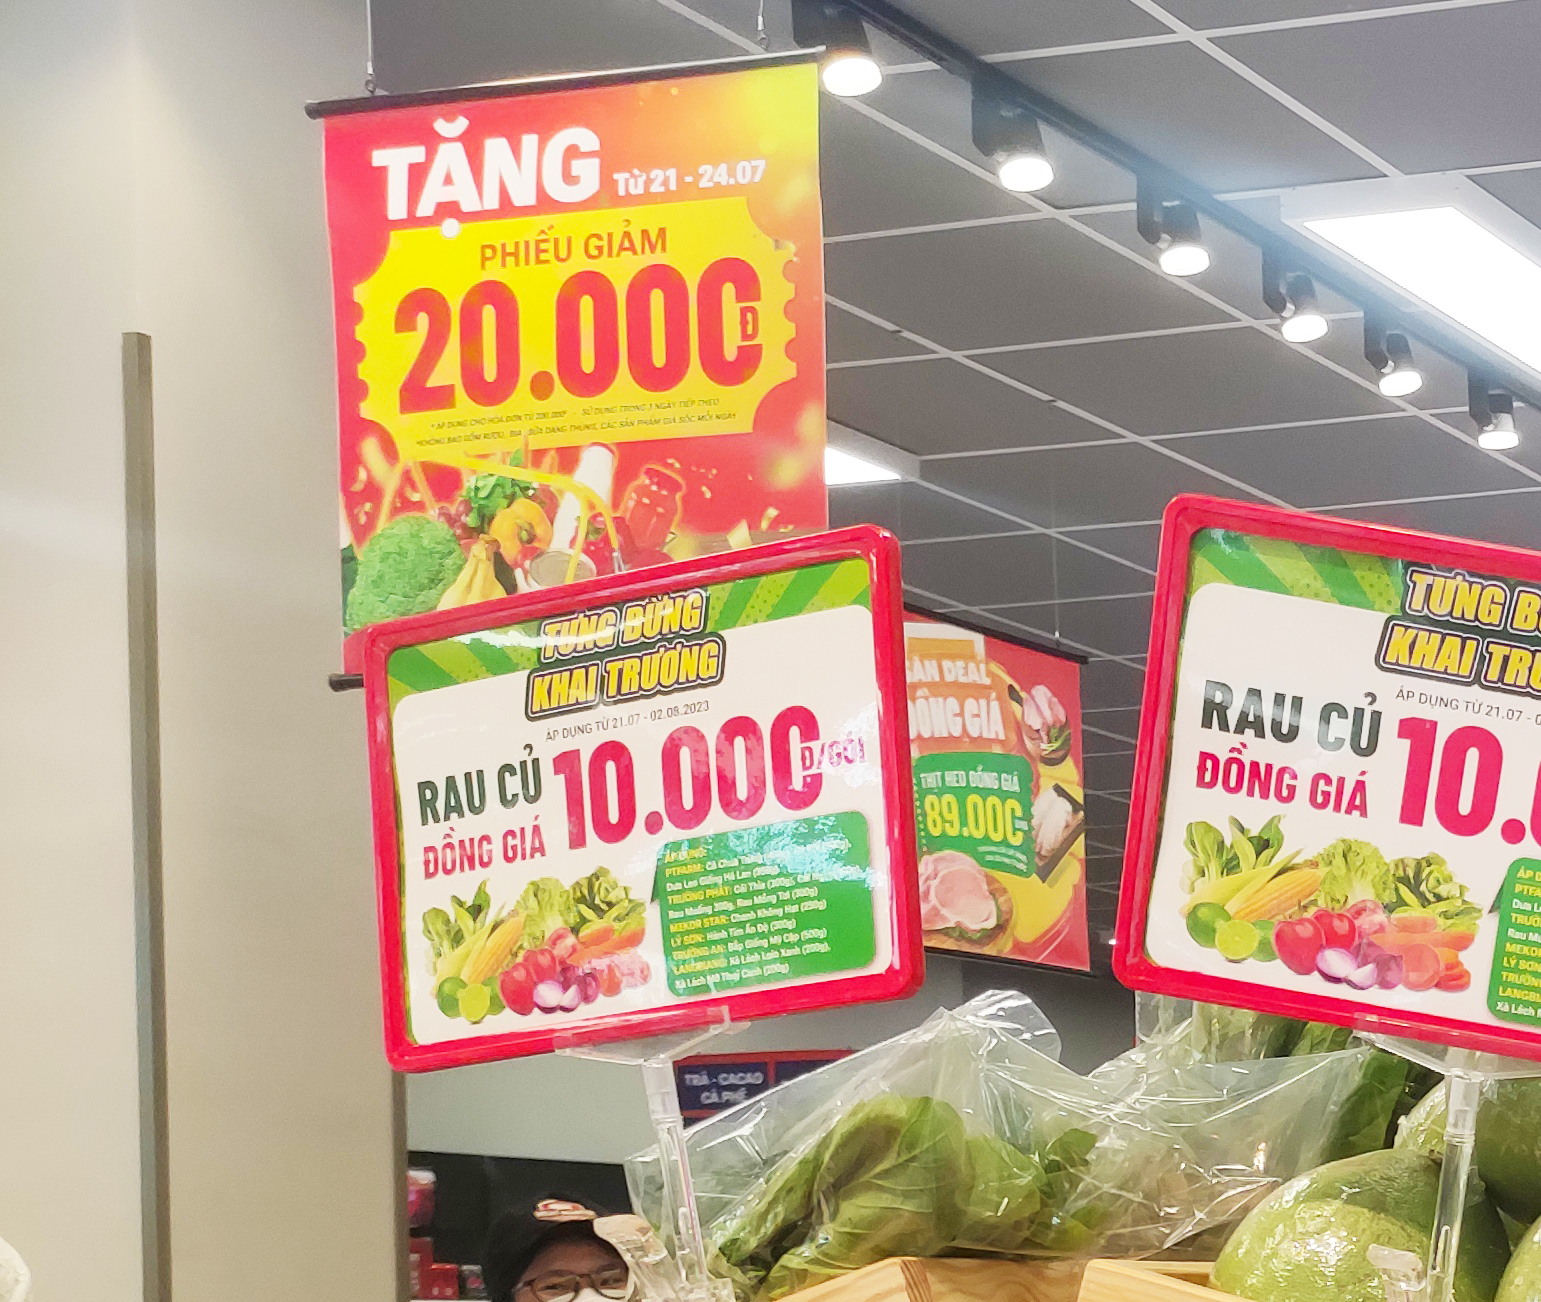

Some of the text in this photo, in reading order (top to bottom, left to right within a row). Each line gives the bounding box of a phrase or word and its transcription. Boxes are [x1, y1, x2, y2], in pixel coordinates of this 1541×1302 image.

[372, 115, 601, 239] TẶNG
[613, 171, 646, 197] Từ
[649, 168, 677, 193] 21
[698, 160, 767, 190] 24.07
[481, 219, 668, 270] PHIẾU GIẢM
[1410, 571, 1507, 626] TƯNG
[531, 642, 720, 713] KHAI TRƯƠNG
[942, 659, 991, 685] DEAL
[1384, 626, 1479, 677] KHAI
[562, 722, 593, 740] DỤNG
[612, 713, 641, 729] 21.07
[963, 692, 1006, 740] GIÁ
[1200, 680, 1382, 758] RAU CỦ
[1395, 684, 1415, 701] ÁP
[1419, 692, 1459, 711] DỤNG
[1464, 698, 1484, 715] TỪ
[1486, 704, 1522, 722] 21.07
[417, 744, 542, 827] RAU CỦ
[1196, 742, 1368, 819] ĐỒNG GIÁ
[422, 814, 546, 880] ĐỒNG GIÁ
